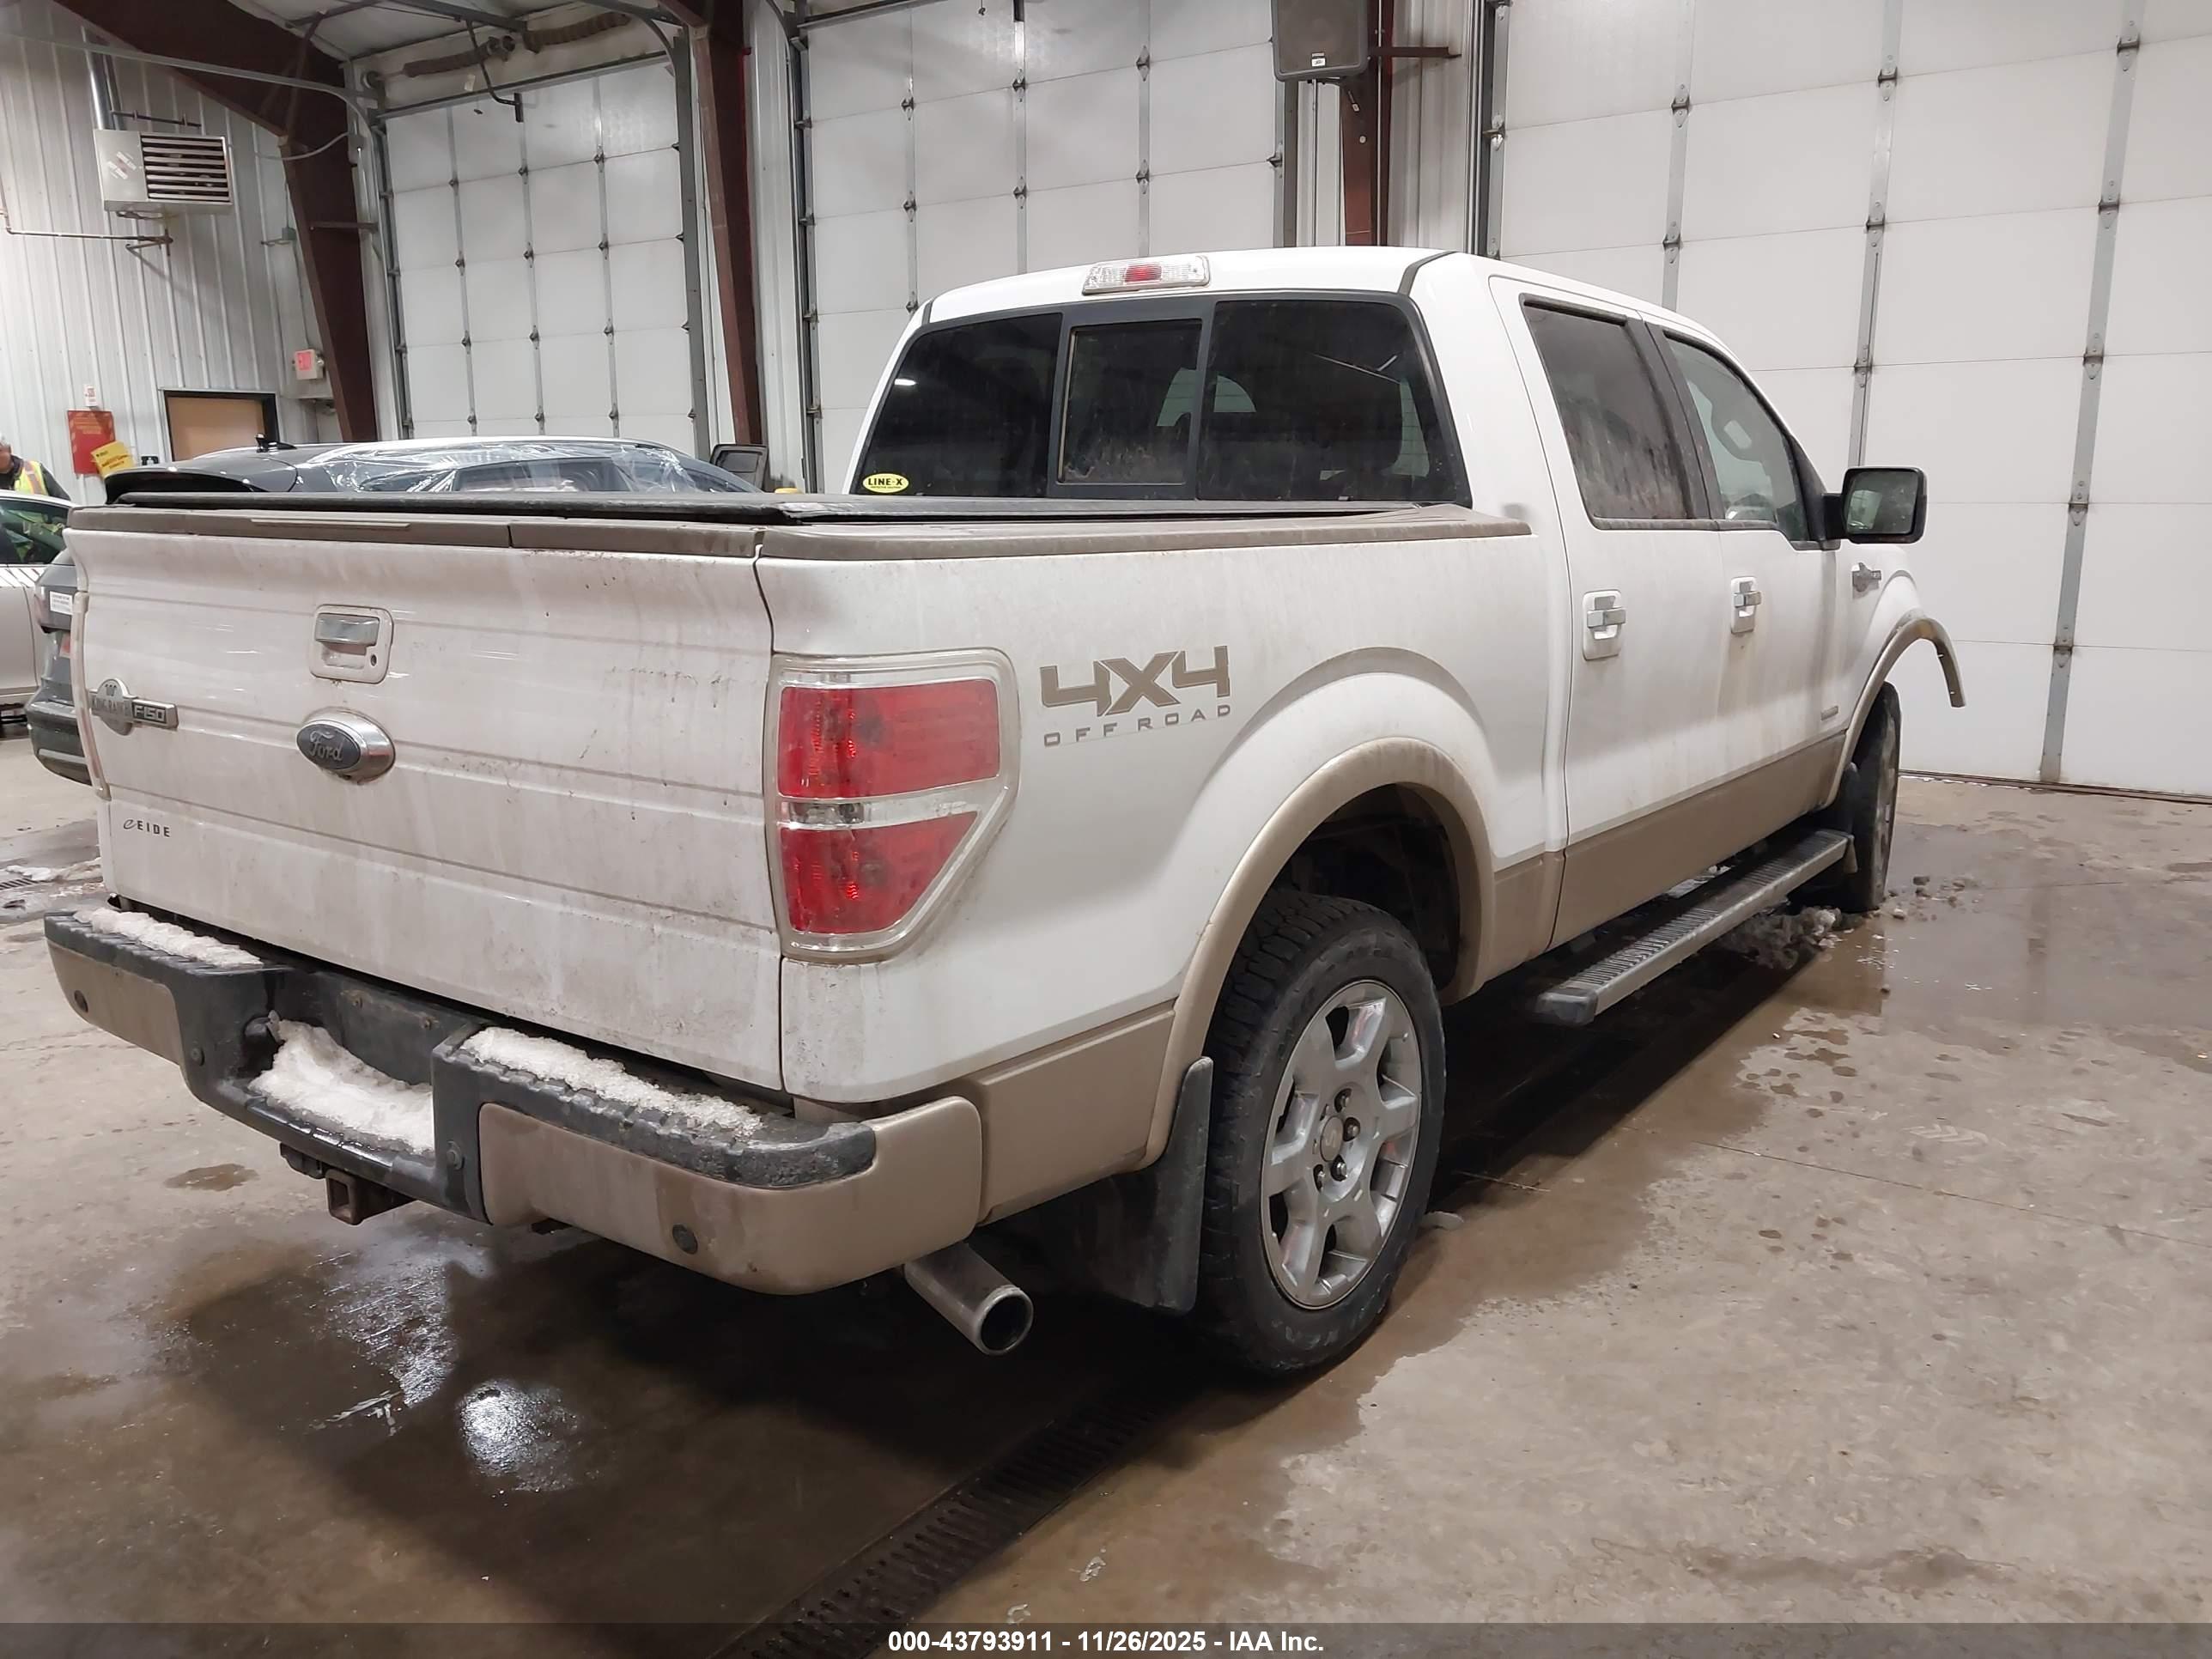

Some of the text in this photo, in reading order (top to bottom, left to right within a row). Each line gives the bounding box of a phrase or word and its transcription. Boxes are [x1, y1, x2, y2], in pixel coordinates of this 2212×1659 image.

[867, 477, 903, 486] LINE-X
[1040, 645, 1231, 717] 4X4
[309, 730, 344, 762] Ford
